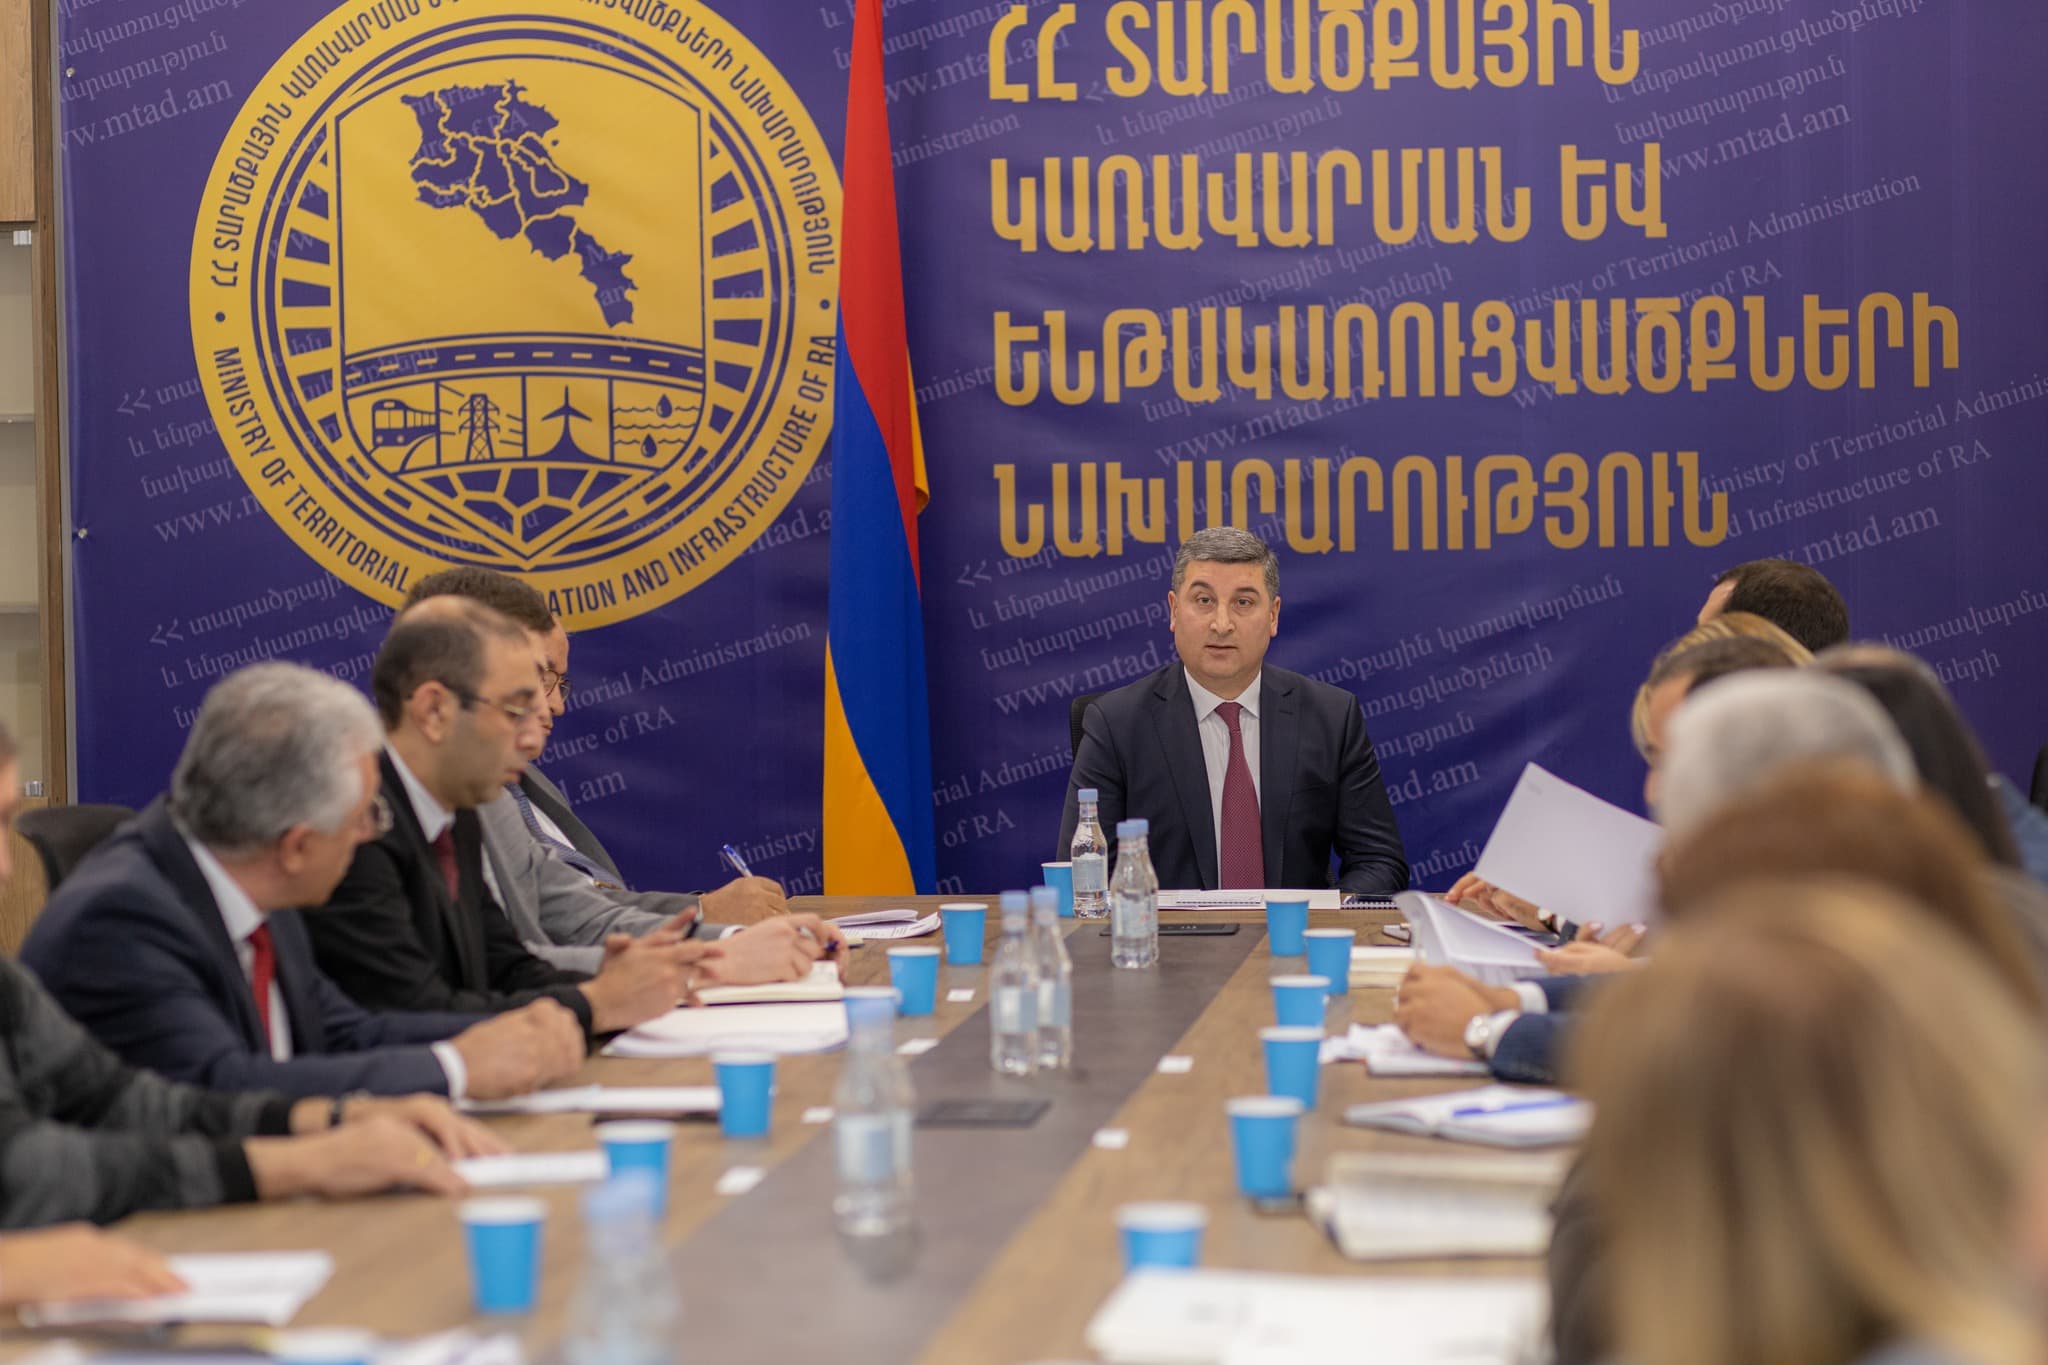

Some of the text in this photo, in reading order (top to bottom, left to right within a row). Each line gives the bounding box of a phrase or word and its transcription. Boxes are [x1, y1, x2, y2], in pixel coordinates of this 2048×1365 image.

[988, 3, 1079, 103] ՀՀ
[1105, 0, 1640, 97] ՏԱՐԱԾՔԱՅԻՆ
[991, 146, 1531, 253] ԿԱՌԱՎԱՐՄԱՆ
[1560, 143, 1667, 240] ԵՎ
[1745, 173, 1921, 245] Administration
[806, 334, 837, 367] RA
[993, 291, 1960, 406] ԵՆԹԱԿԱՌՈՒՑՎԱԾՔՆԵՐԻ
[212, 346, 276, 459] MINISTRY
[796, 369, 830, 404] OF
[1823, 403, 1950, 461] Territorial
[261, 457, 296, 489] OF
[667, 404, 818, 577] INFRASTRUCTURE
[1747, 464, 1912, 533] Infrastructure
[1917, 450, 1945, 479] of
[1947, 439, 1993, 471] RA
[283, 486, 411, 594] TERRITORIAL
[548, 577, 618, 617] ATION
[620, 559, 670, 602] AND
[639, 620, 812, 690] Administration
[633, 704, 678, 735] RA
[943, 807, 1017, 848] of RA
